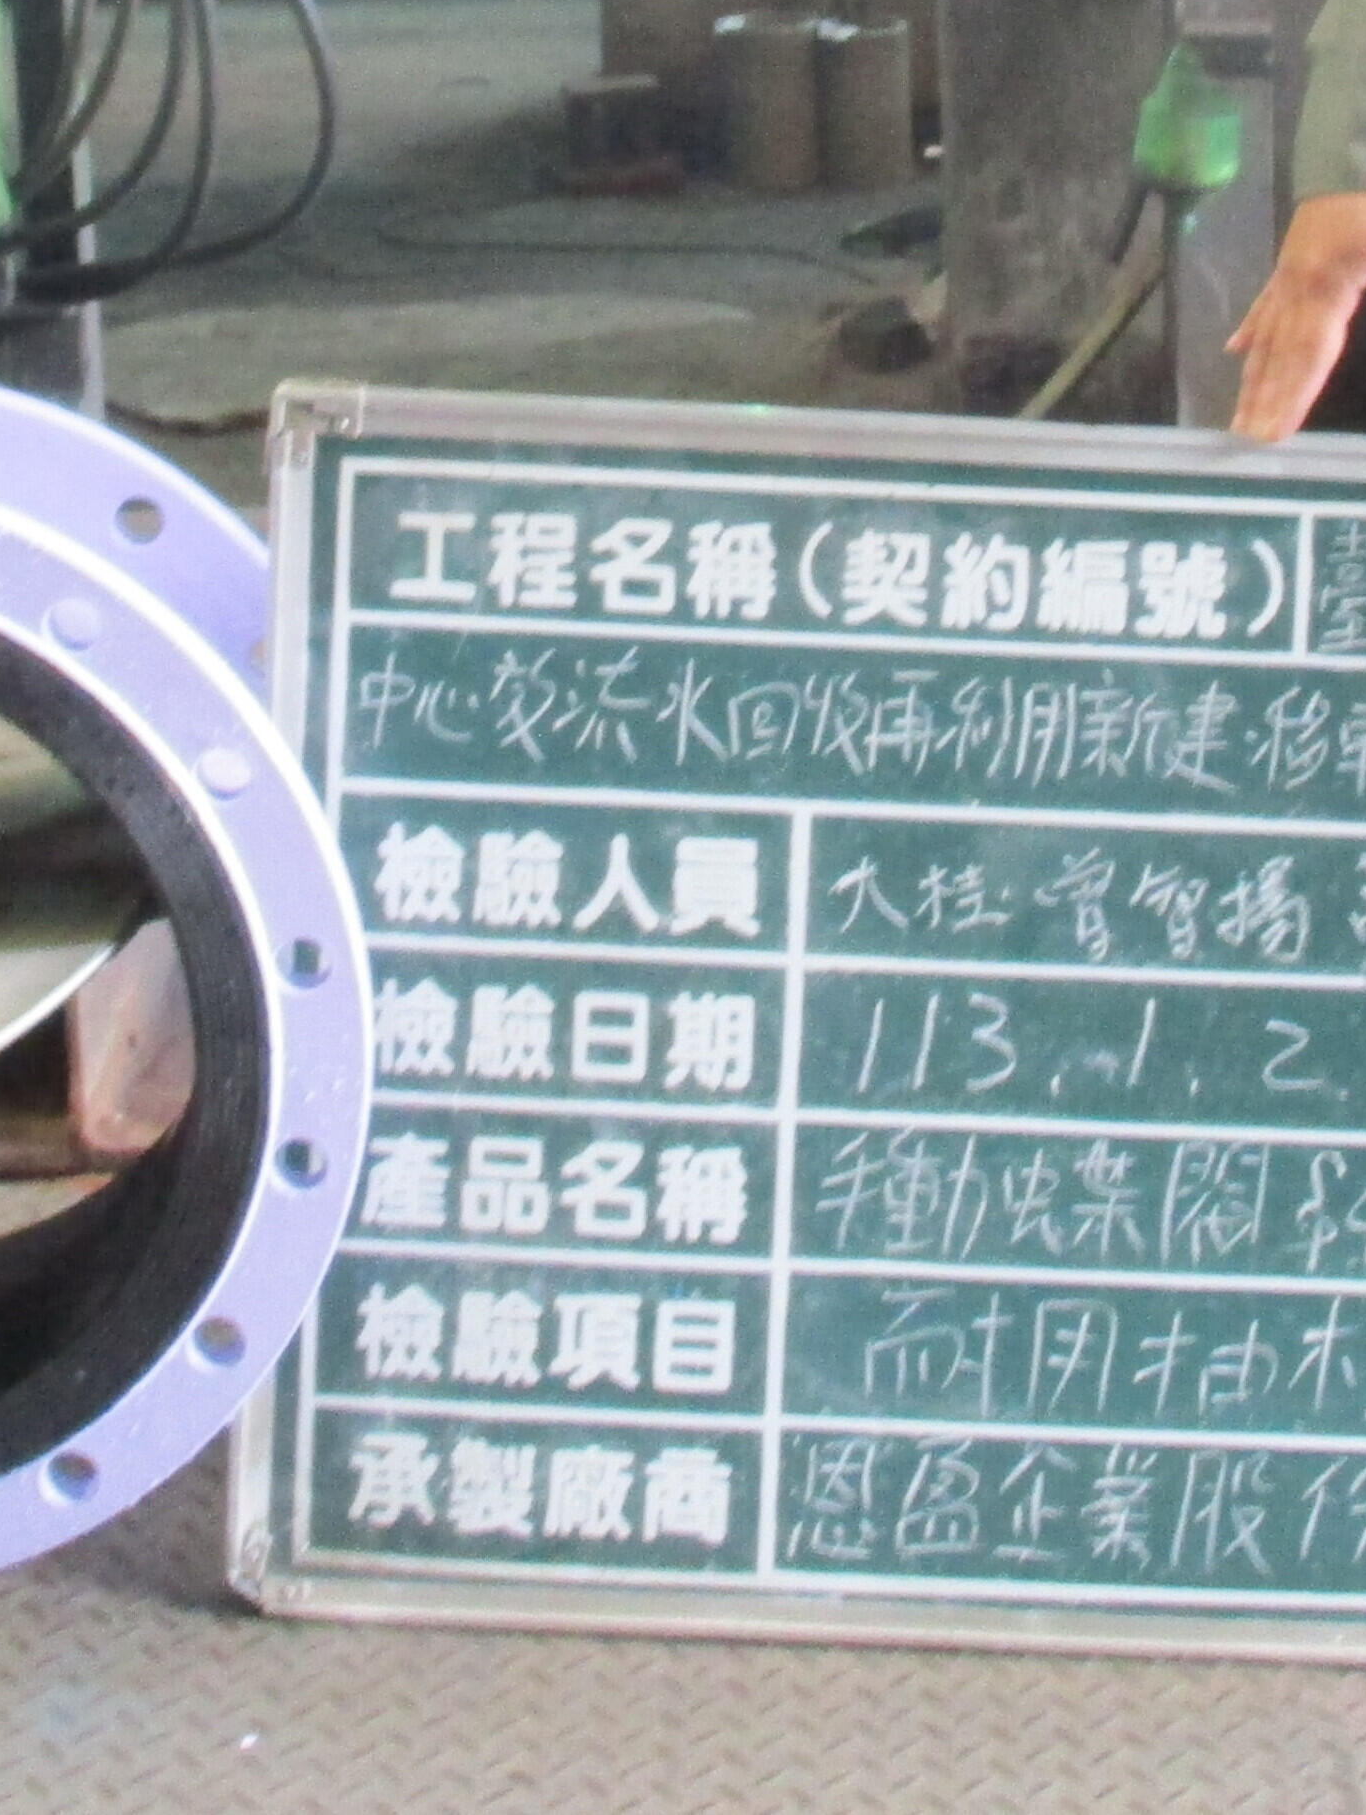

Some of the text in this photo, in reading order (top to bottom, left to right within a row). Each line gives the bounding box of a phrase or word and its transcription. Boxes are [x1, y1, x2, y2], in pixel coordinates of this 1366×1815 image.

[387, 508, 1283, 641] 工程名稱(契約編號)
[375, 825, 760, 938] 檢驗人員
[373, 977, 755, 1093] 檢驗日期
[360, 1132, 747, 1244] 產品名稱
[355, 1281, 736, 1395] 檢驗項目
[347, 1430, 733, 1545] 承製廠商
